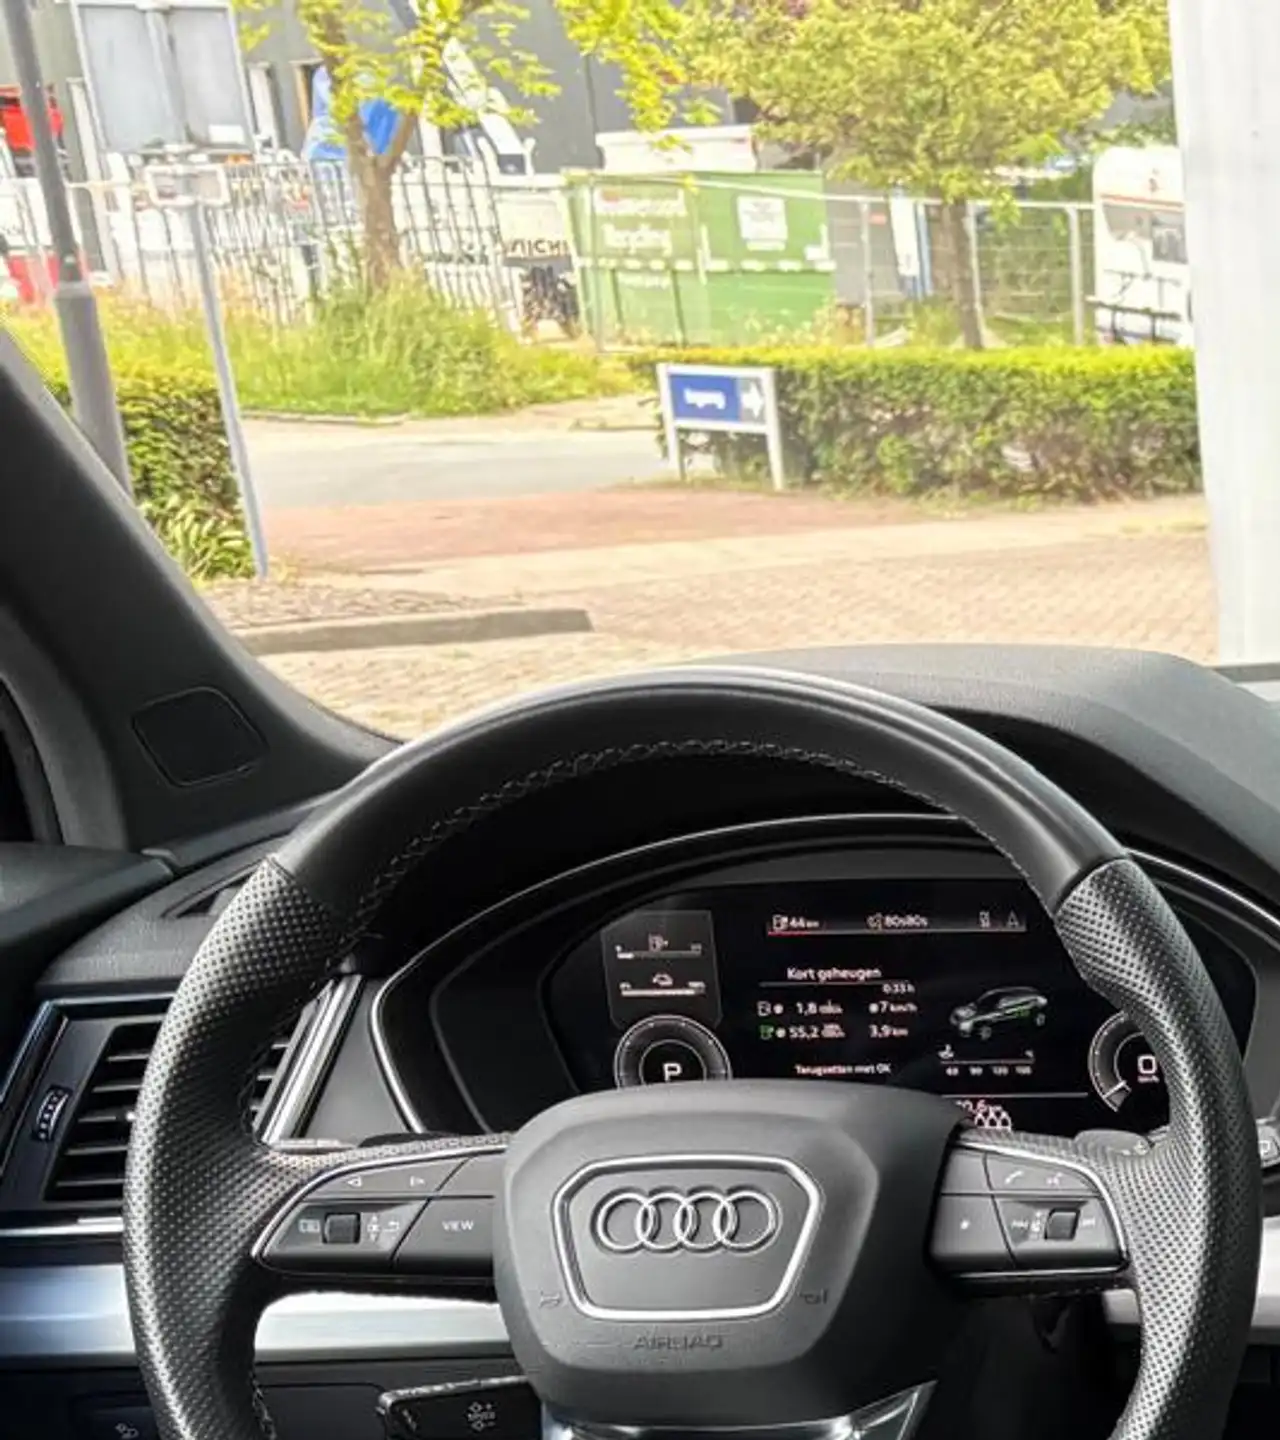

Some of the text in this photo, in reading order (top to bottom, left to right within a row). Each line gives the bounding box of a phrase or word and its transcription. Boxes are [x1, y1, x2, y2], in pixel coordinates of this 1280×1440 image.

[787, 967, 882, 983] Kort geheugen
[663, 1062, 682, 1082] P
[876, 1063, 891, 1073] OK
[442, 1220, 474, 1231] VIEW
